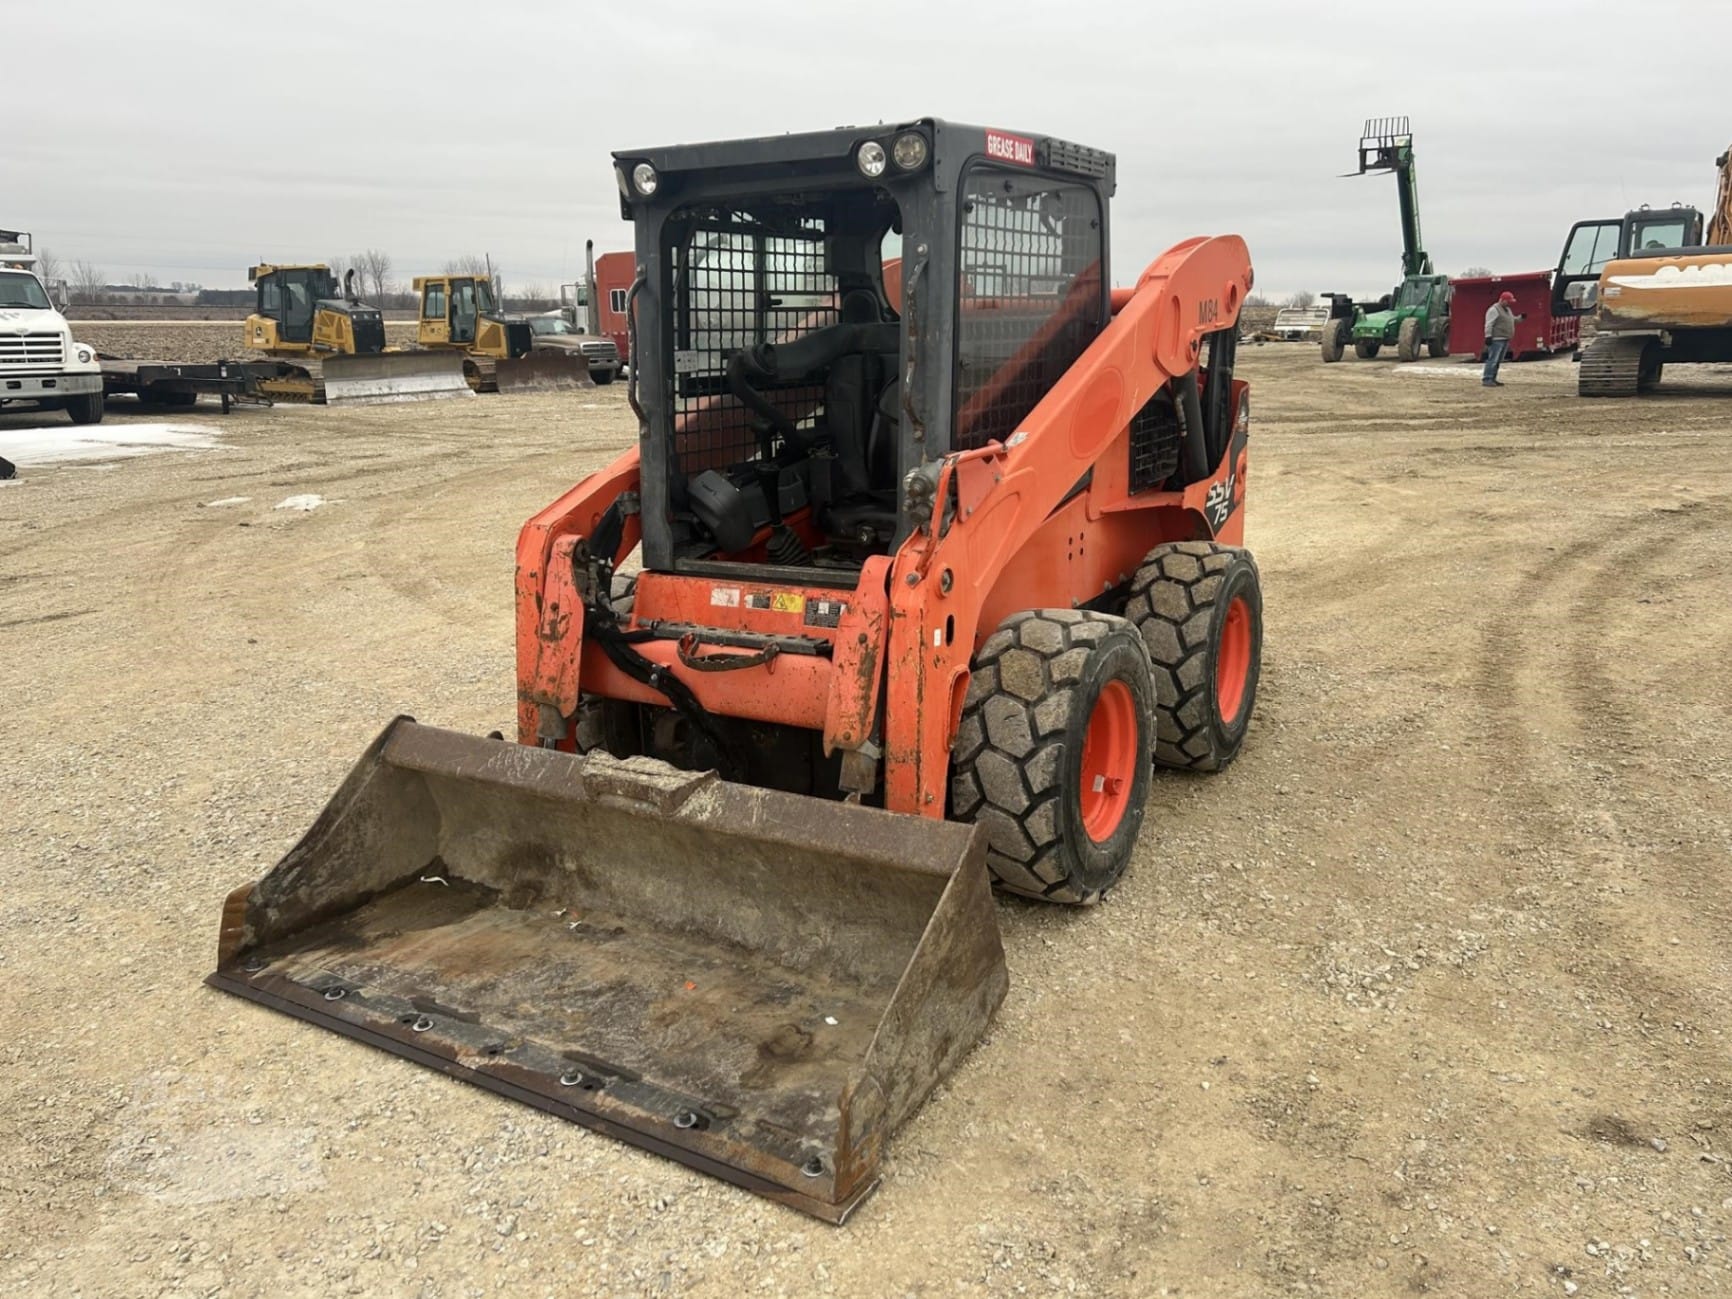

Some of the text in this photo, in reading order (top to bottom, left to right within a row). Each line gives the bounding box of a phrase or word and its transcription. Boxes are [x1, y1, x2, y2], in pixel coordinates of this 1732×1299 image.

[988, 134, 1032, 163] GREASE DAILY
[1199, 299, 1218, 325] M84
[1206, 474, 1235, 508] SSV
[1214, 501, 1228, 525] 75
